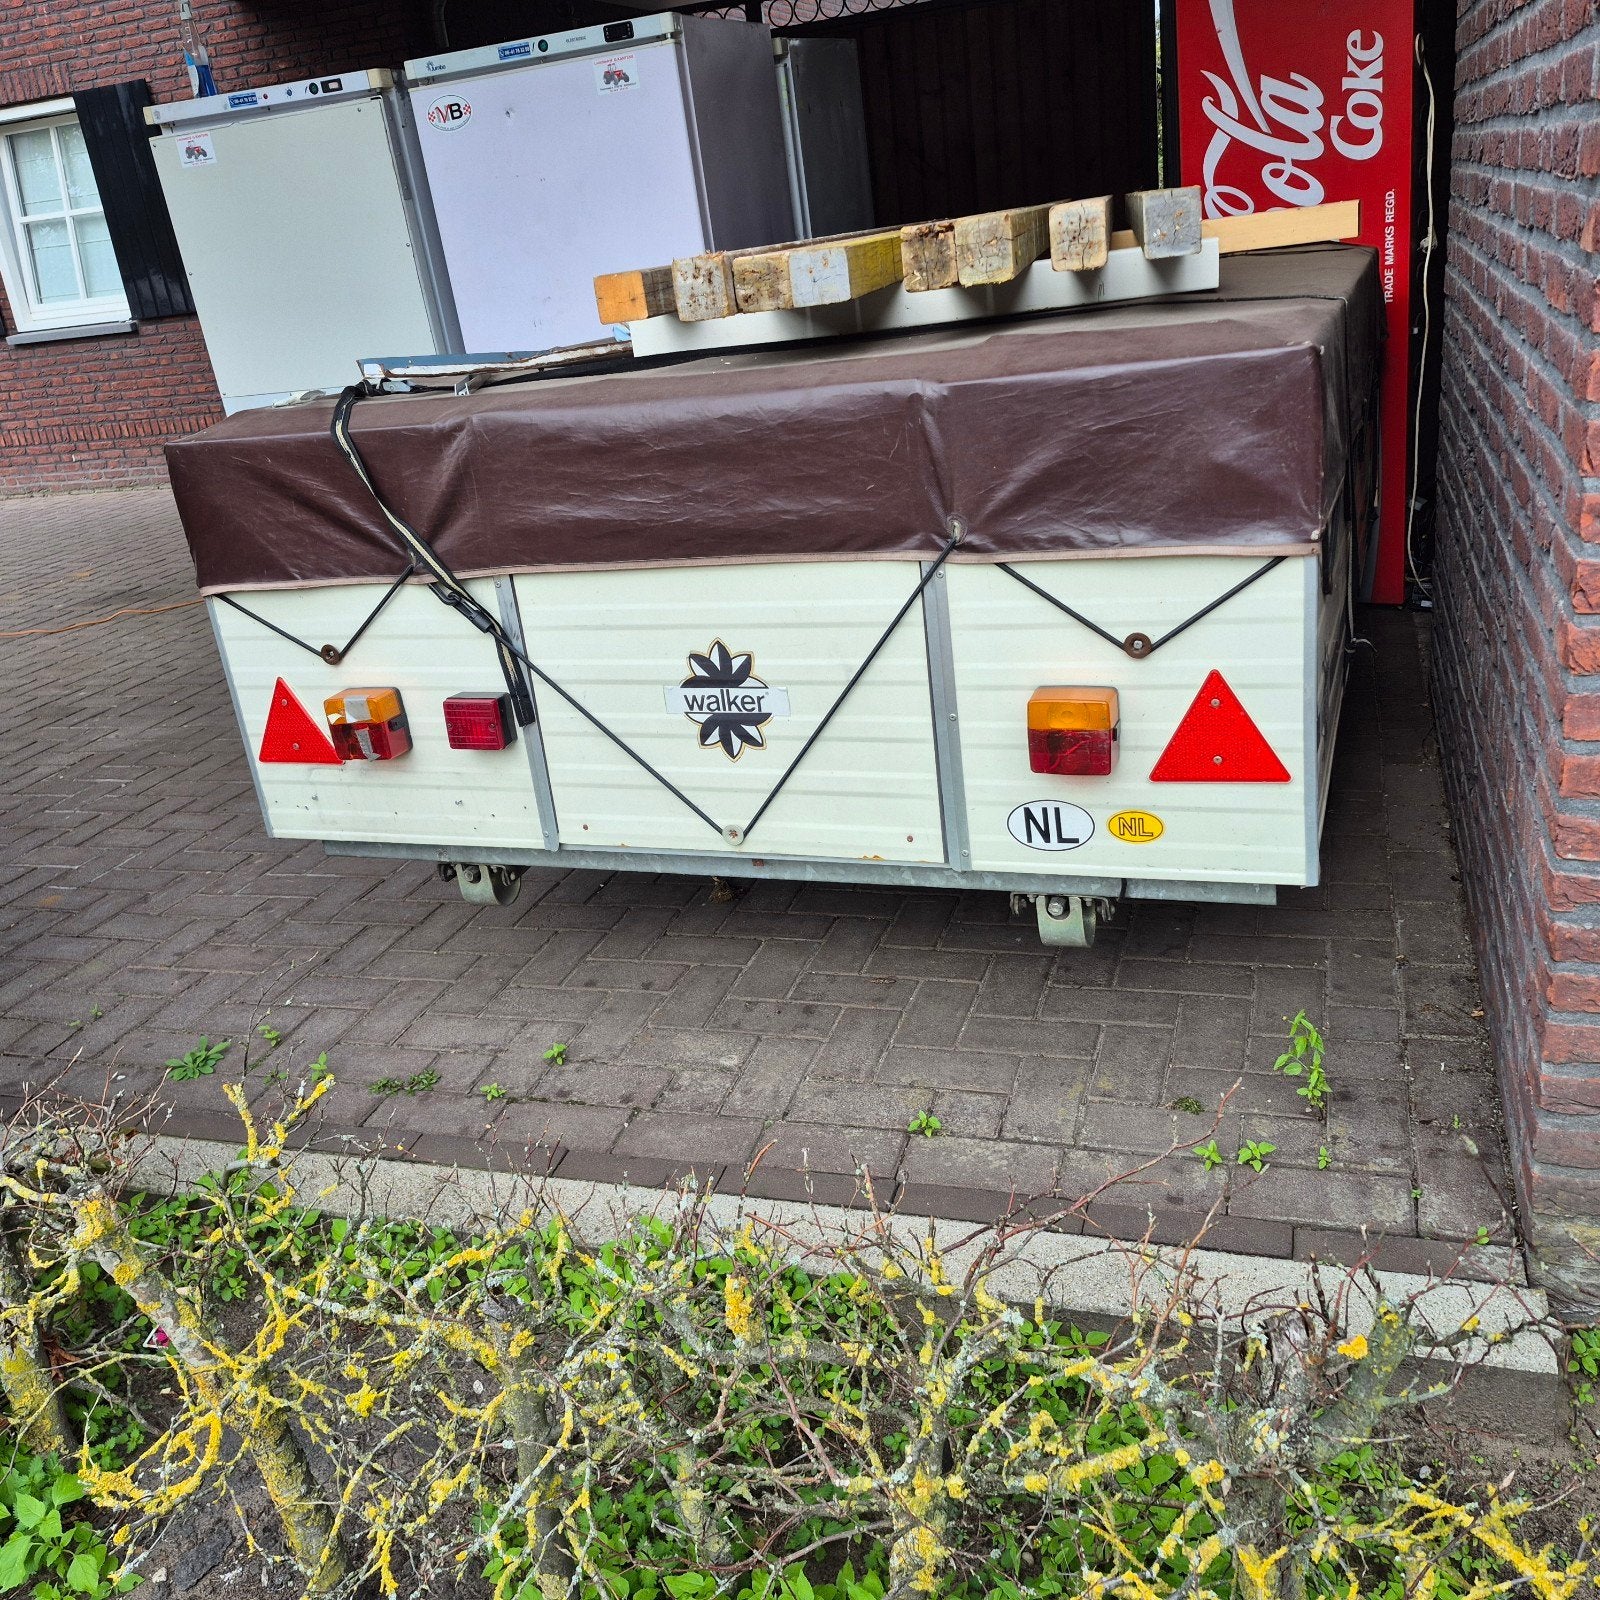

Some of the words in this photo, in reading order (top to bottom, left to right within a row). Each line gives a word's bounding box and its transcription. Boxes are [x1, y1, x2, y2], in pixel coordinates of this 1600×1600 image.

[1329, 28, 1384, 161] Coke
[1385, 188, 1395, 223] REGD.
[1384, 225, 1395, 266] MARKS
[1384, 267, 1394, 305] TRADE
[683, 688, 765, 713] walker
[1023, 806, 1080, 844] NL
[1118, 816, 1154, 837] NL
